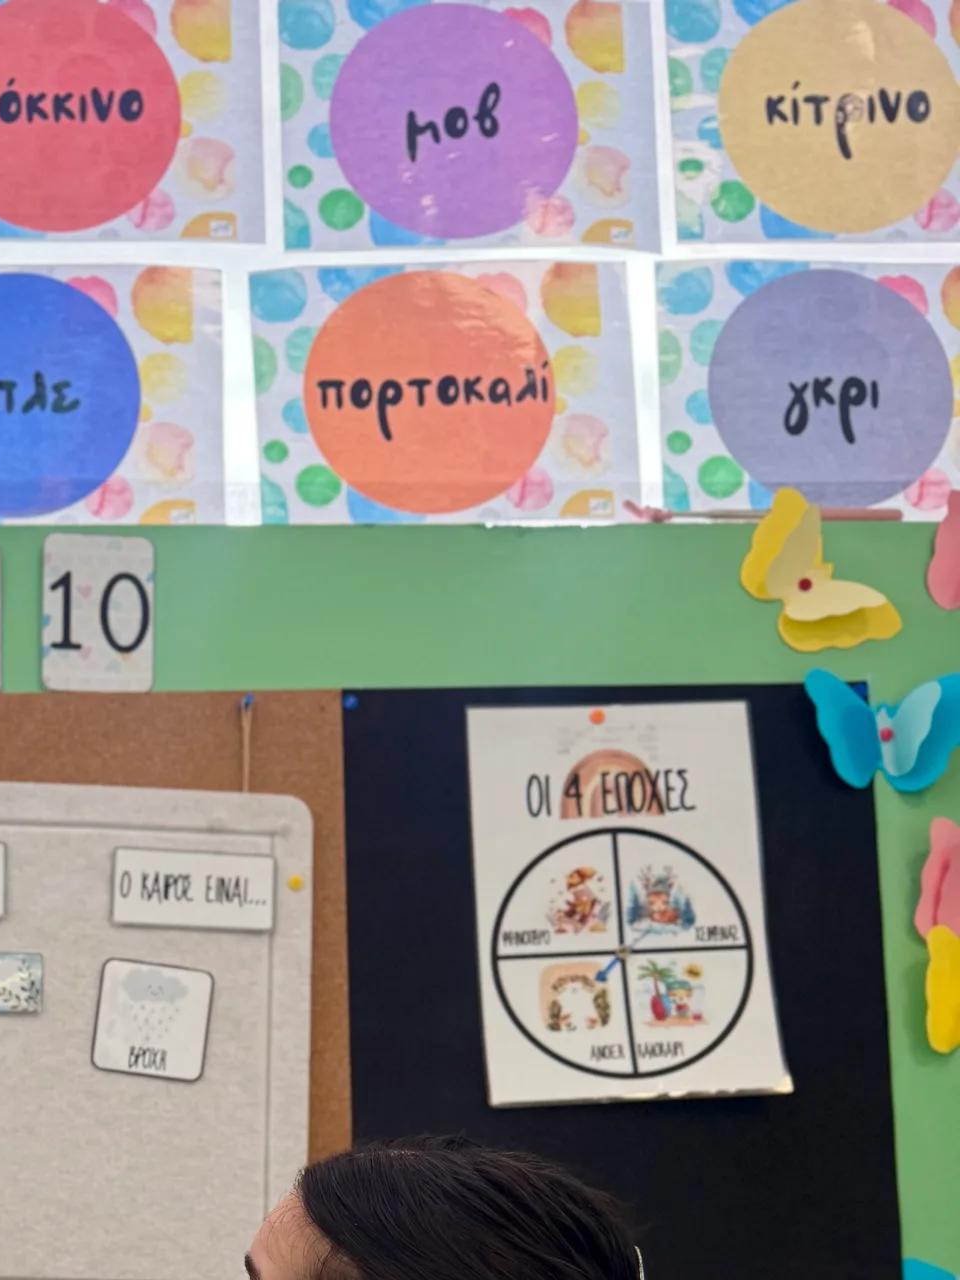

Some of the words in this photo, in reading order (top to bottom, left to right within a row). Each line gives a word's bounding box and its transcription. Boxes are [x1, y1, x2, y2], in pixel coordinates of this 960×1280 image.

[406, 81, 501, 163] μοβ
[765, 80, 931, 161] κίτρινο
[316, 360, 551, 442] πορτοκαλί
[783, 376, 881, 445] γκρι
[49, 570, 150, 654] 10
[526, 773, 552, 818] ΟΙ
[563, 771, 584, 818] 4
[600, 766, 696, 815] ΕΠΟΧΕΣ
[119, 870, 133, 899] Ο
[140, 871, 194, 904] ΚΑΙΡΟΣ
[127, 1045, 168, 1073] ΒΡΟΧΗ
